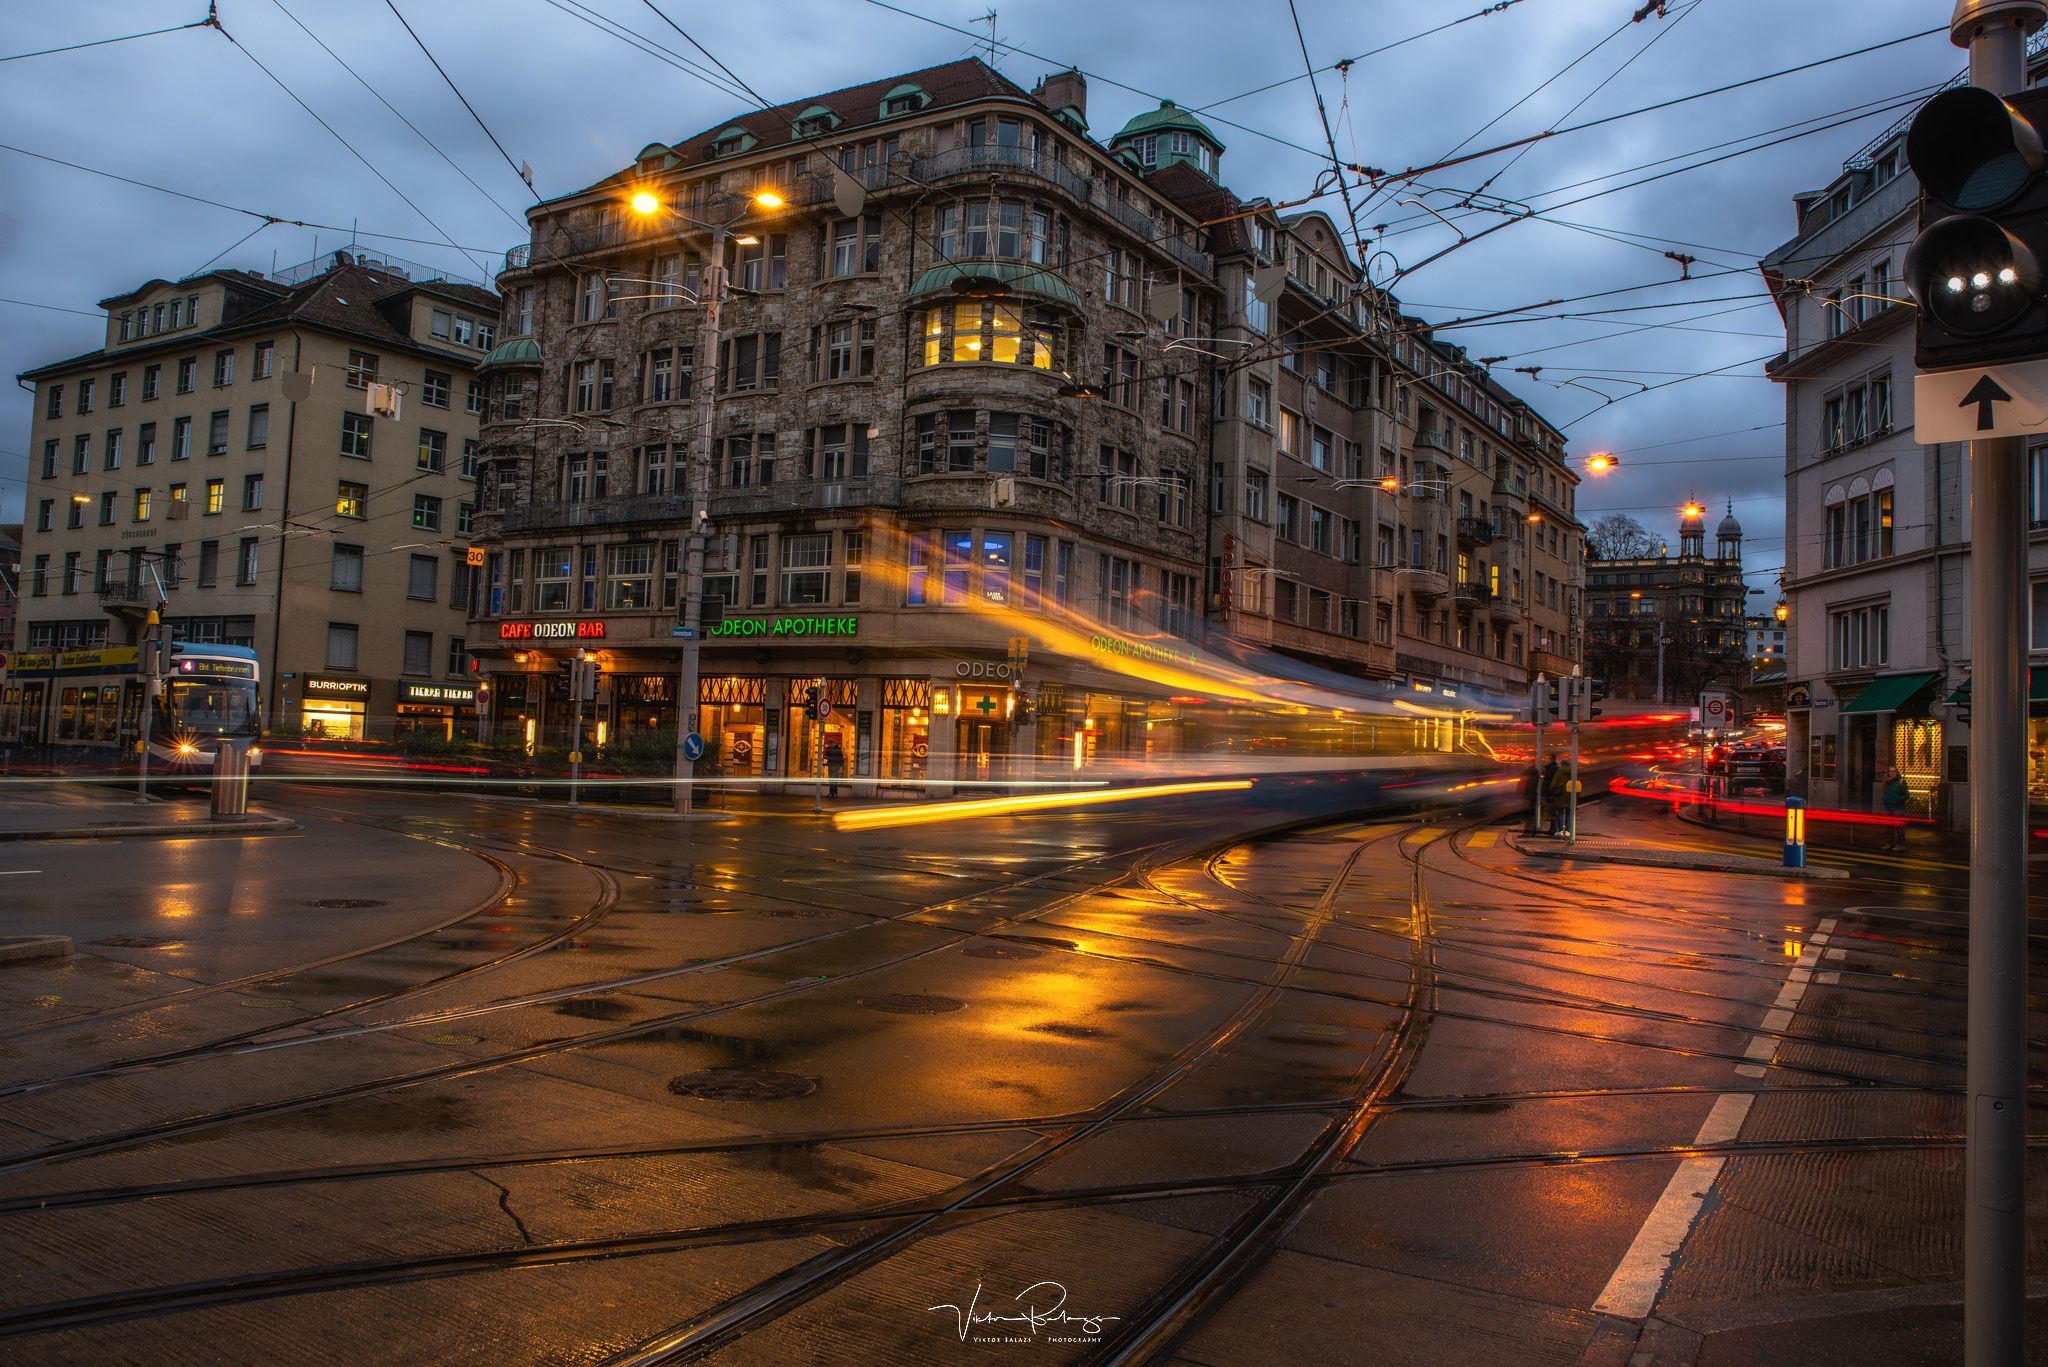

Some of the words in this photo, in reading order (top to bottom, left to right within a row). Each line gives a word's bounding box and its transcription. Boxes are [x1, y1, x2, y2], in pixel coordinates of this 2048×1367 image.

[468, 551, 483, 562] 30
[1222, 533, 1235, 623] SPORT
[501, 623, 531, 638] CAFE
[534, 622, 576, 637] ODEON
[578, 621, 604, 637] BAR
[773, 617, 857, 635] APOTHEKE
[1569, 592, 1577, 656] APOTHEKE
[1092, 635, 1129, 655] ODEON
[1132, 643, 1179, 663] APOTHEKE
[184, 661, 192, 671] 4
[956, 661, 1020, 678] ODEO
[409, 686, 441, 698] TIERRA
